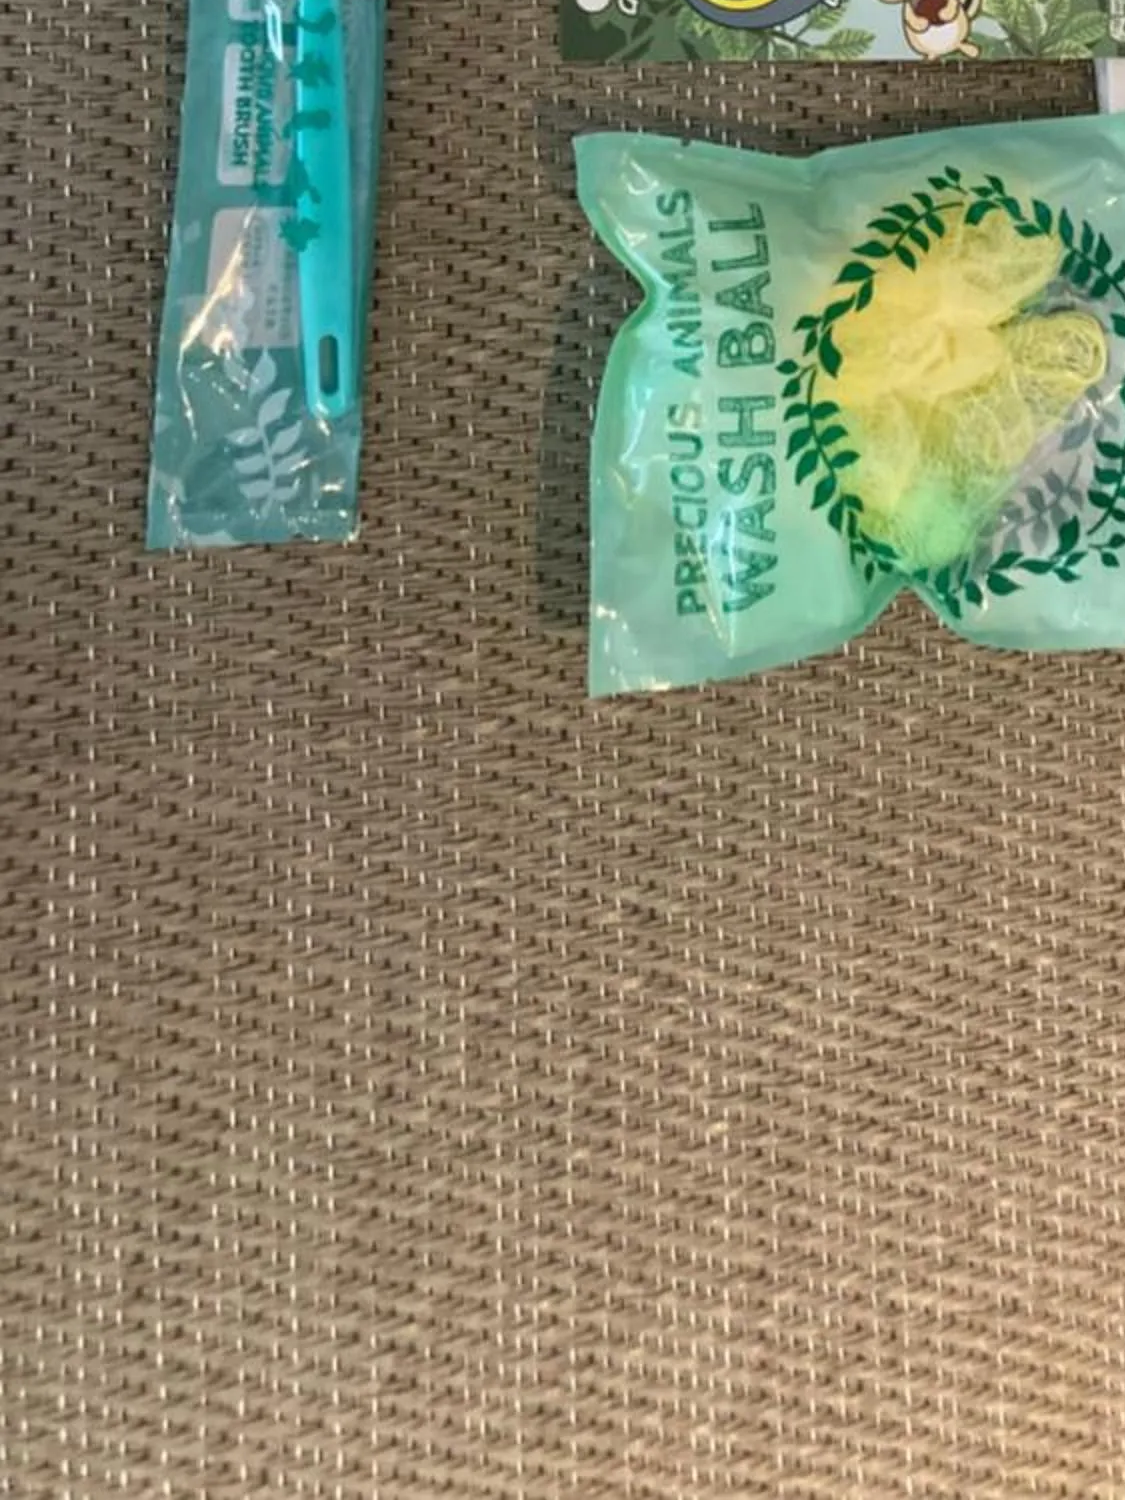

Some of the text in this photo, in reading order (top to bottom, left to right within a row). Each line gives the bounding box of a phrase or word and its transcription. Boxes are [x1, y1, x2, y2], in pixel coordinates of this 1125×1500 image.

[232, 96, 250, 167] BRUSH
[656, 189, 708, 616] PRECIOUS ANIMALS
[708, 203, 779, 613] WASH BALL
